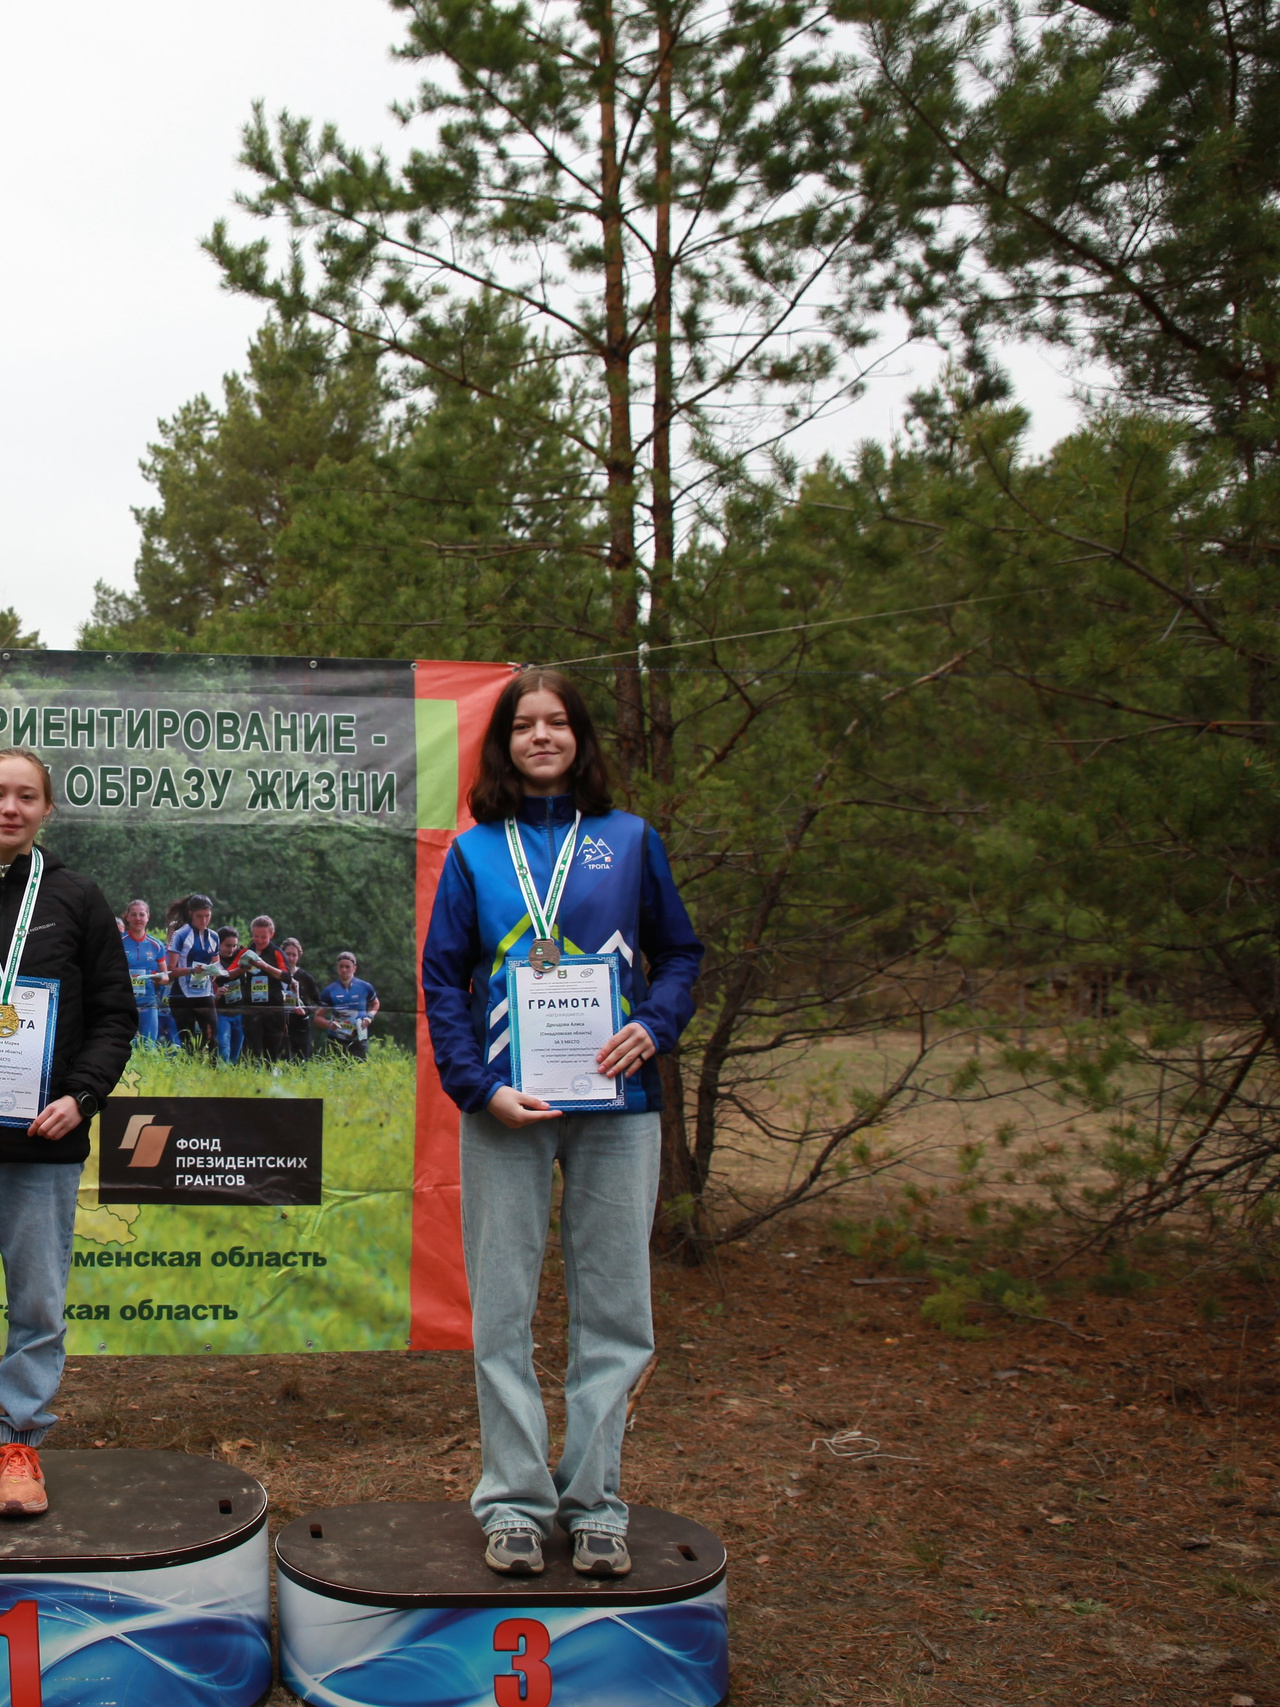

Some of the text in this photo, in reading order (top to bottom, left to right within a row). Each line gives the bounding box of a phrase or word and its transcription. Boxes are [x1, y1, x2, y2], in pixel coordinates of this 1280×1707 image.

[65, 765, 232, 809] ОБРАЗУ
[247, 769, 397, 814] ЖИЗНИ
[528, 997, 600, 1010] ГРАМОТА
[176, 1138, 222, 1152] ФОНД
[176, 1156, 308, 1170] ПРЕЗИДЕНТСКИХ
[176, 1174, 246, 1187] ГРАНТОВ
[71, 1245, 328, 1267] менская область
[119, 1298, 239, 1321] область
[492, 1618, 553, 1707] 3
